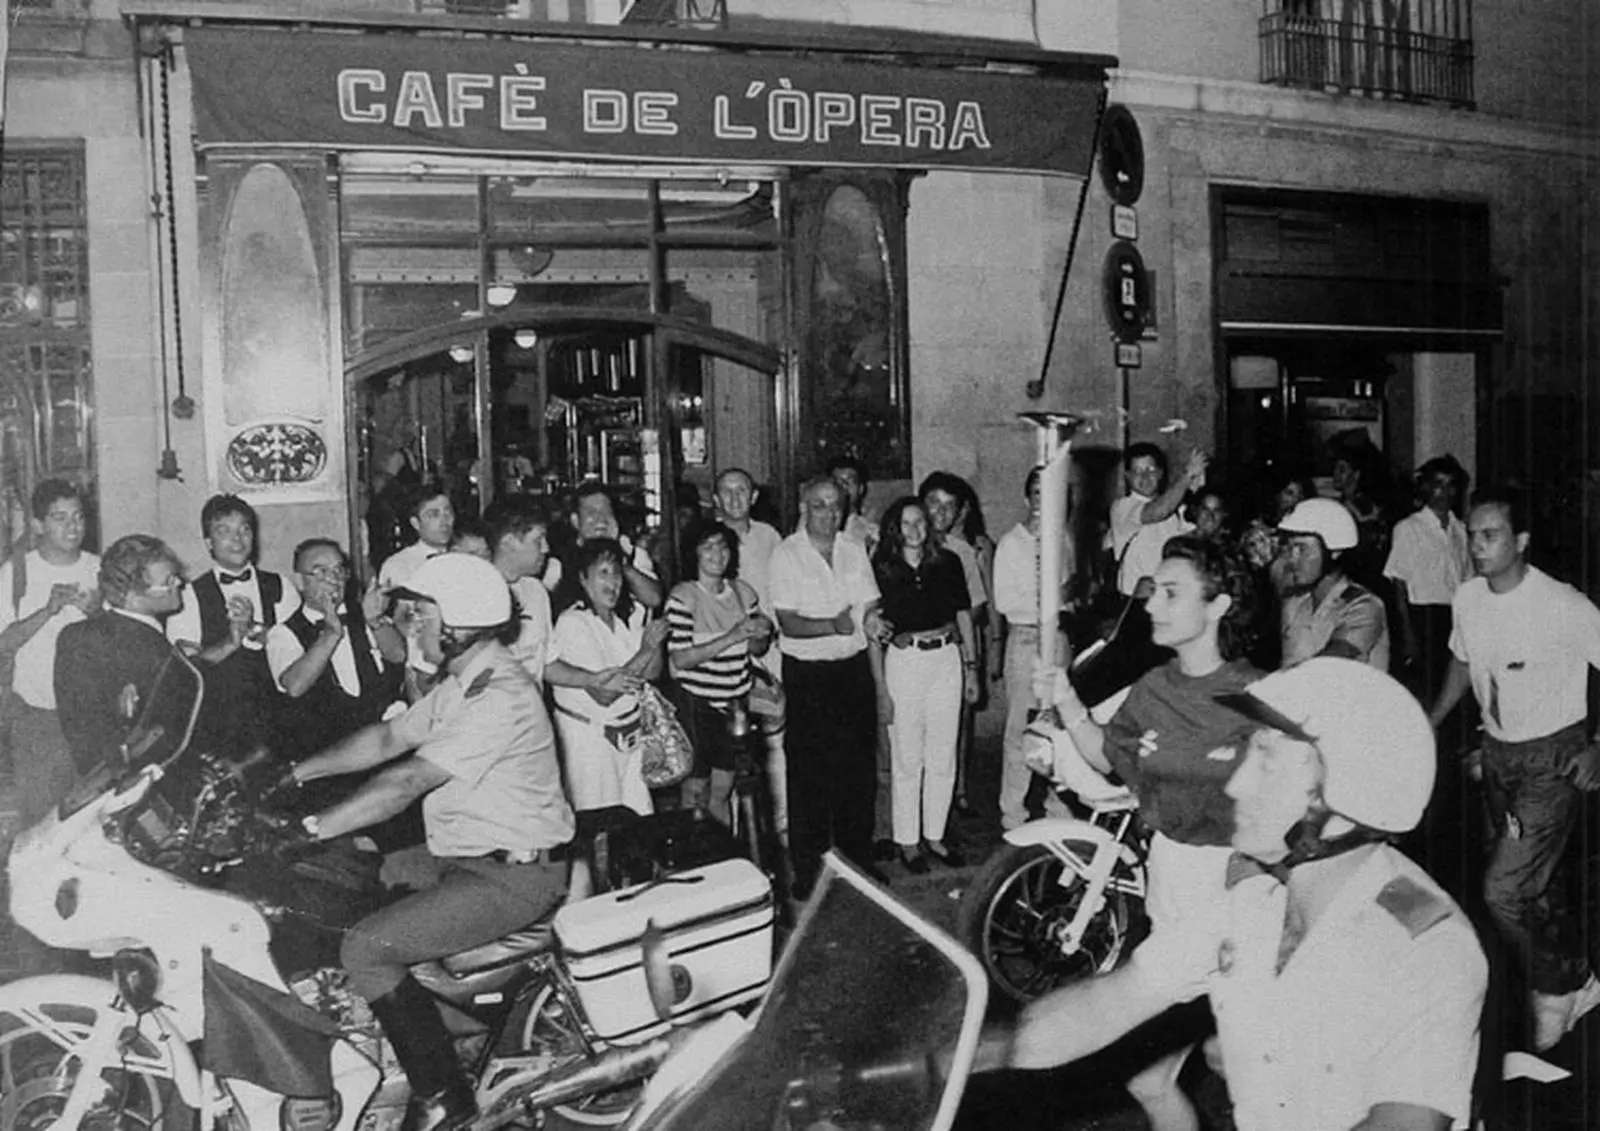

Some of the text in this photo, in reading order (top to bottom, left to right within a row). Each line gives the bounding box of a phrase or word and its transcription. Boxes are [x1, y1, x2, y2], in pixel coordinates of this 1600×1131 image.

[337, 63, 991, 149] CAFÈ DE L'ÒPERA
